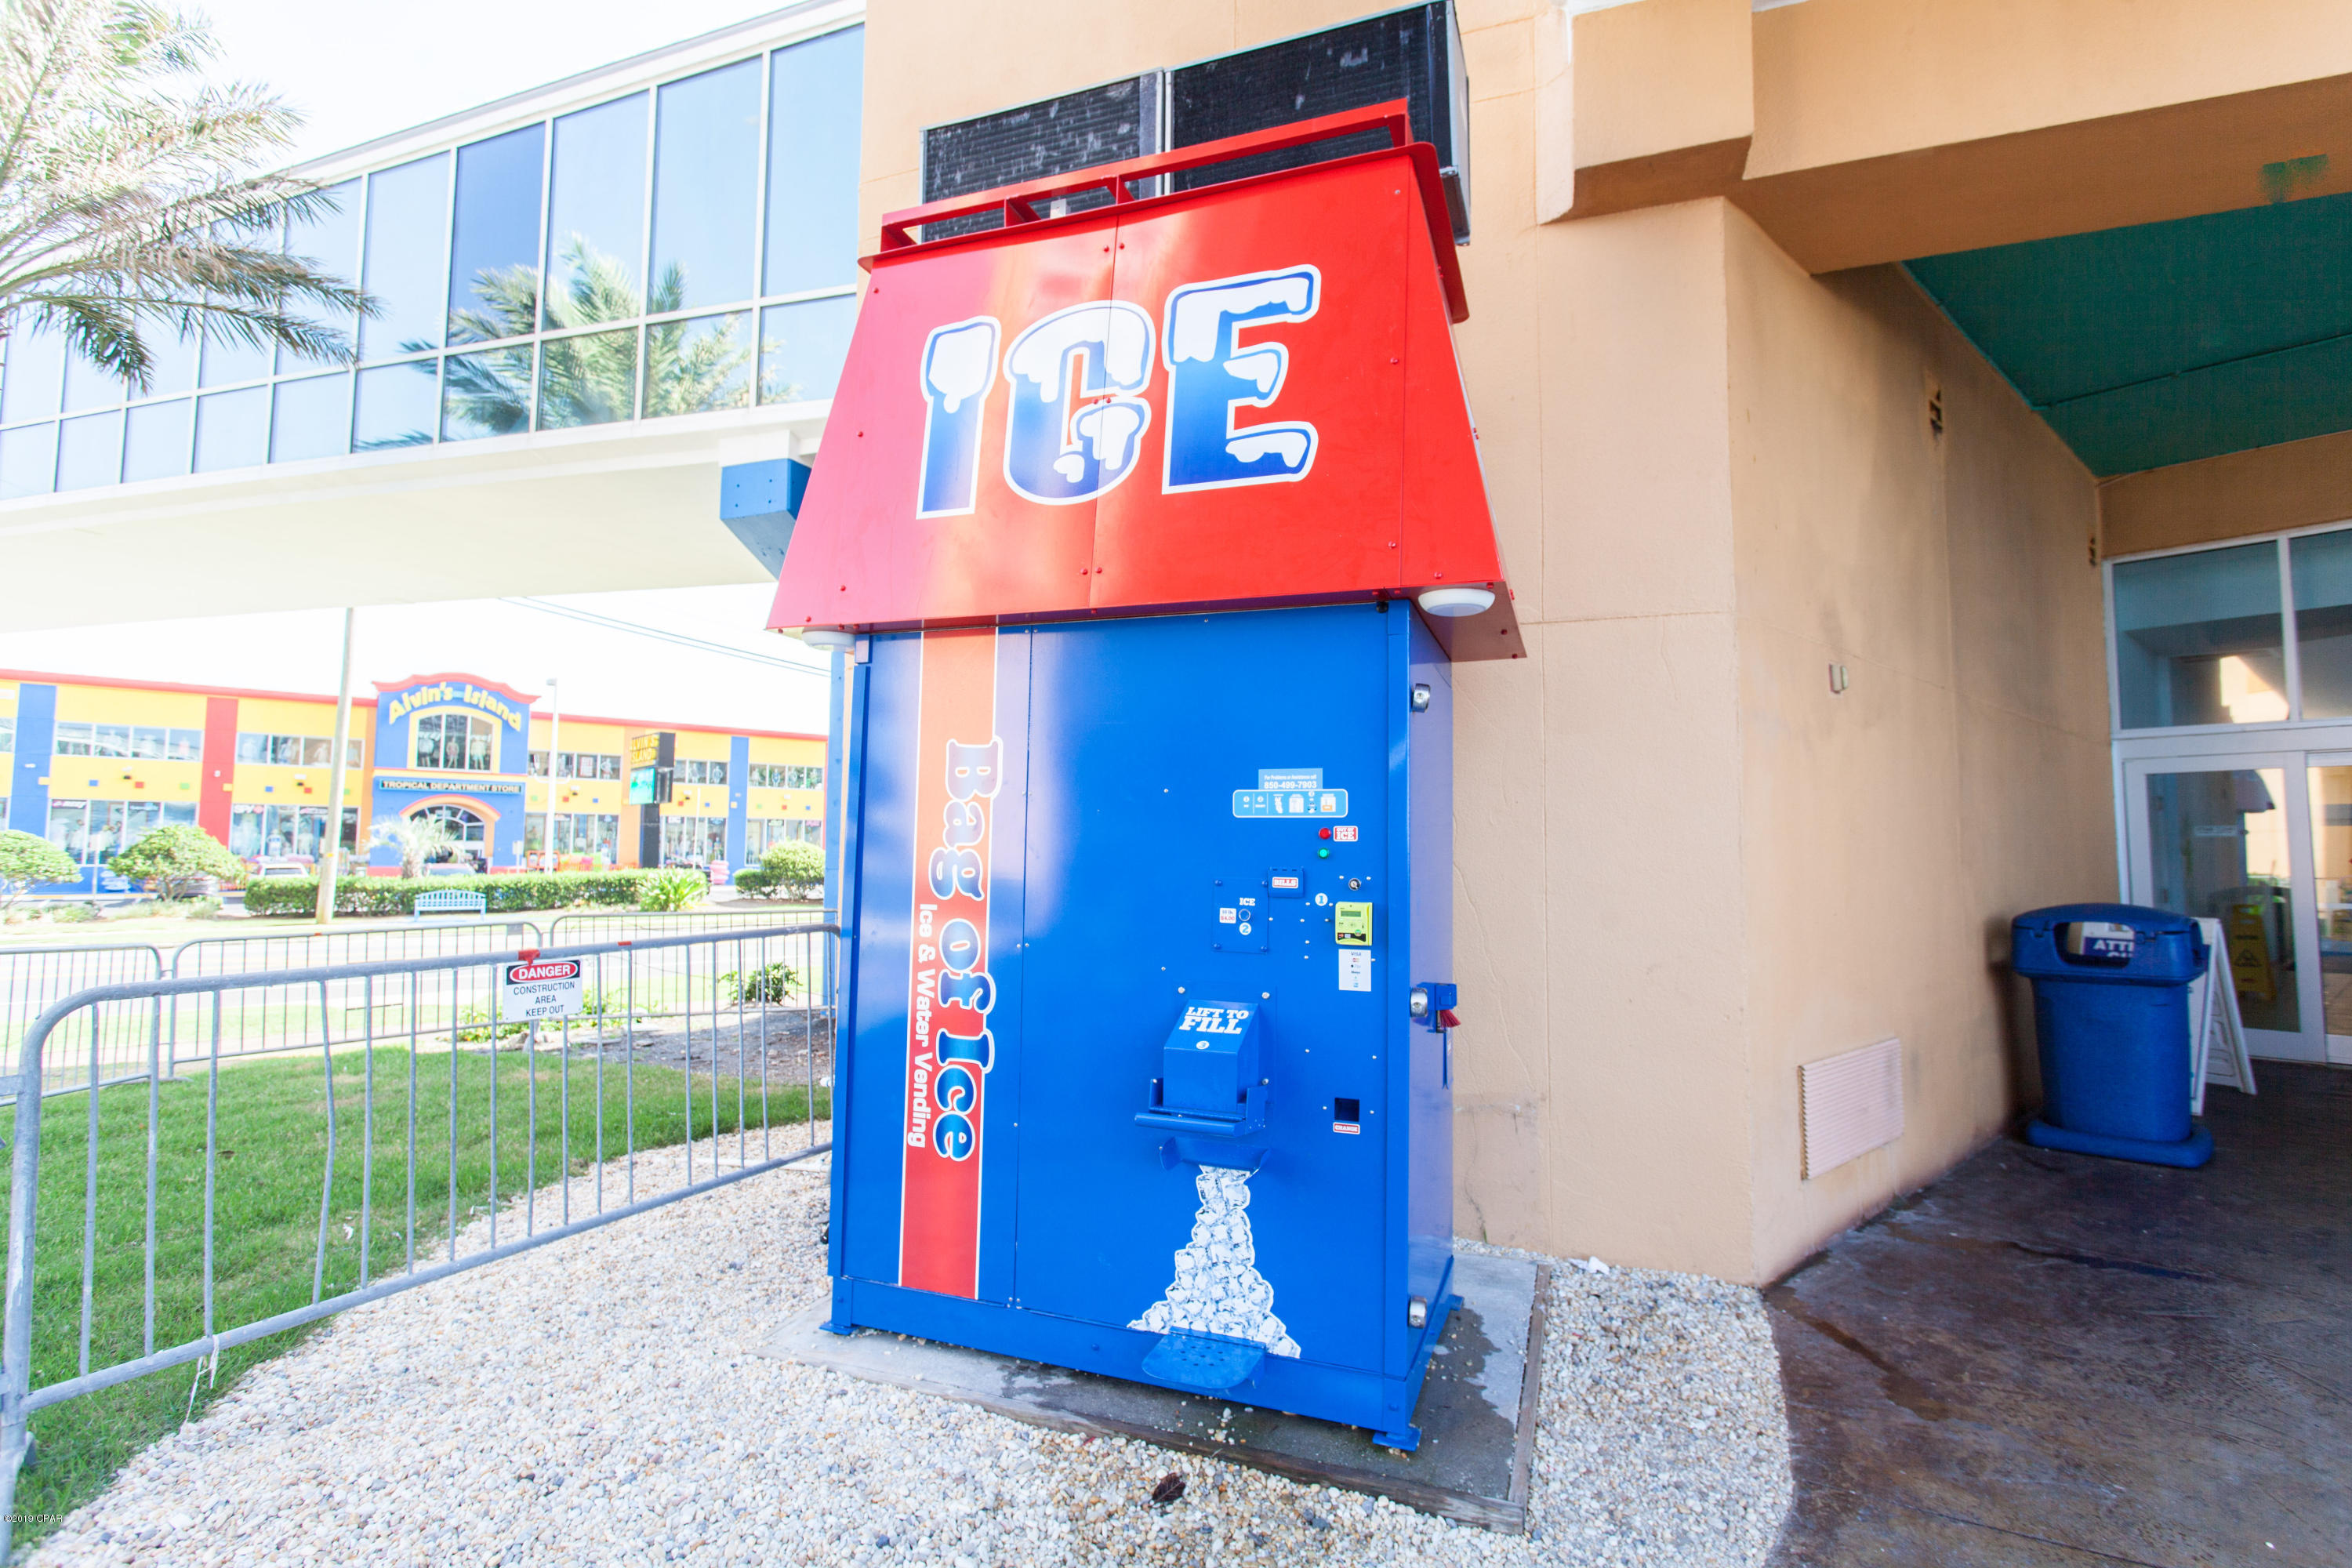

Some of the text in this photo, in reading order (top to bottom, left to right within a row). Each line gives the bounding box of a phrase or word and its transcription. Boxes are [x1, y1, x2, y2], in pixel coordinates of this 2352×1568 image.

[916, 264, 1321, 519] ICE
[389, 681, 521, 731] Alvin's Island
[382, 781, 521, 793] TROPICAL DEPARTMENT STORE
[1239, 897, 1256, 906] ICE
[929, 735, 1003, 1161] Bag of Ice
[518, 964, 571, 980] DANGER
[514, 981, 575, 996] CONSTRUCTION
[535, 995, 557, 1004] AREA
[526, 1004, 564, 1017] KEEP OUT
[1185, 1007, 1250, 1019] LIFT TO
[908, 904, 937, 1148] Ice & Water Vending
[1178, 1015, 1243, 1034] FILL
